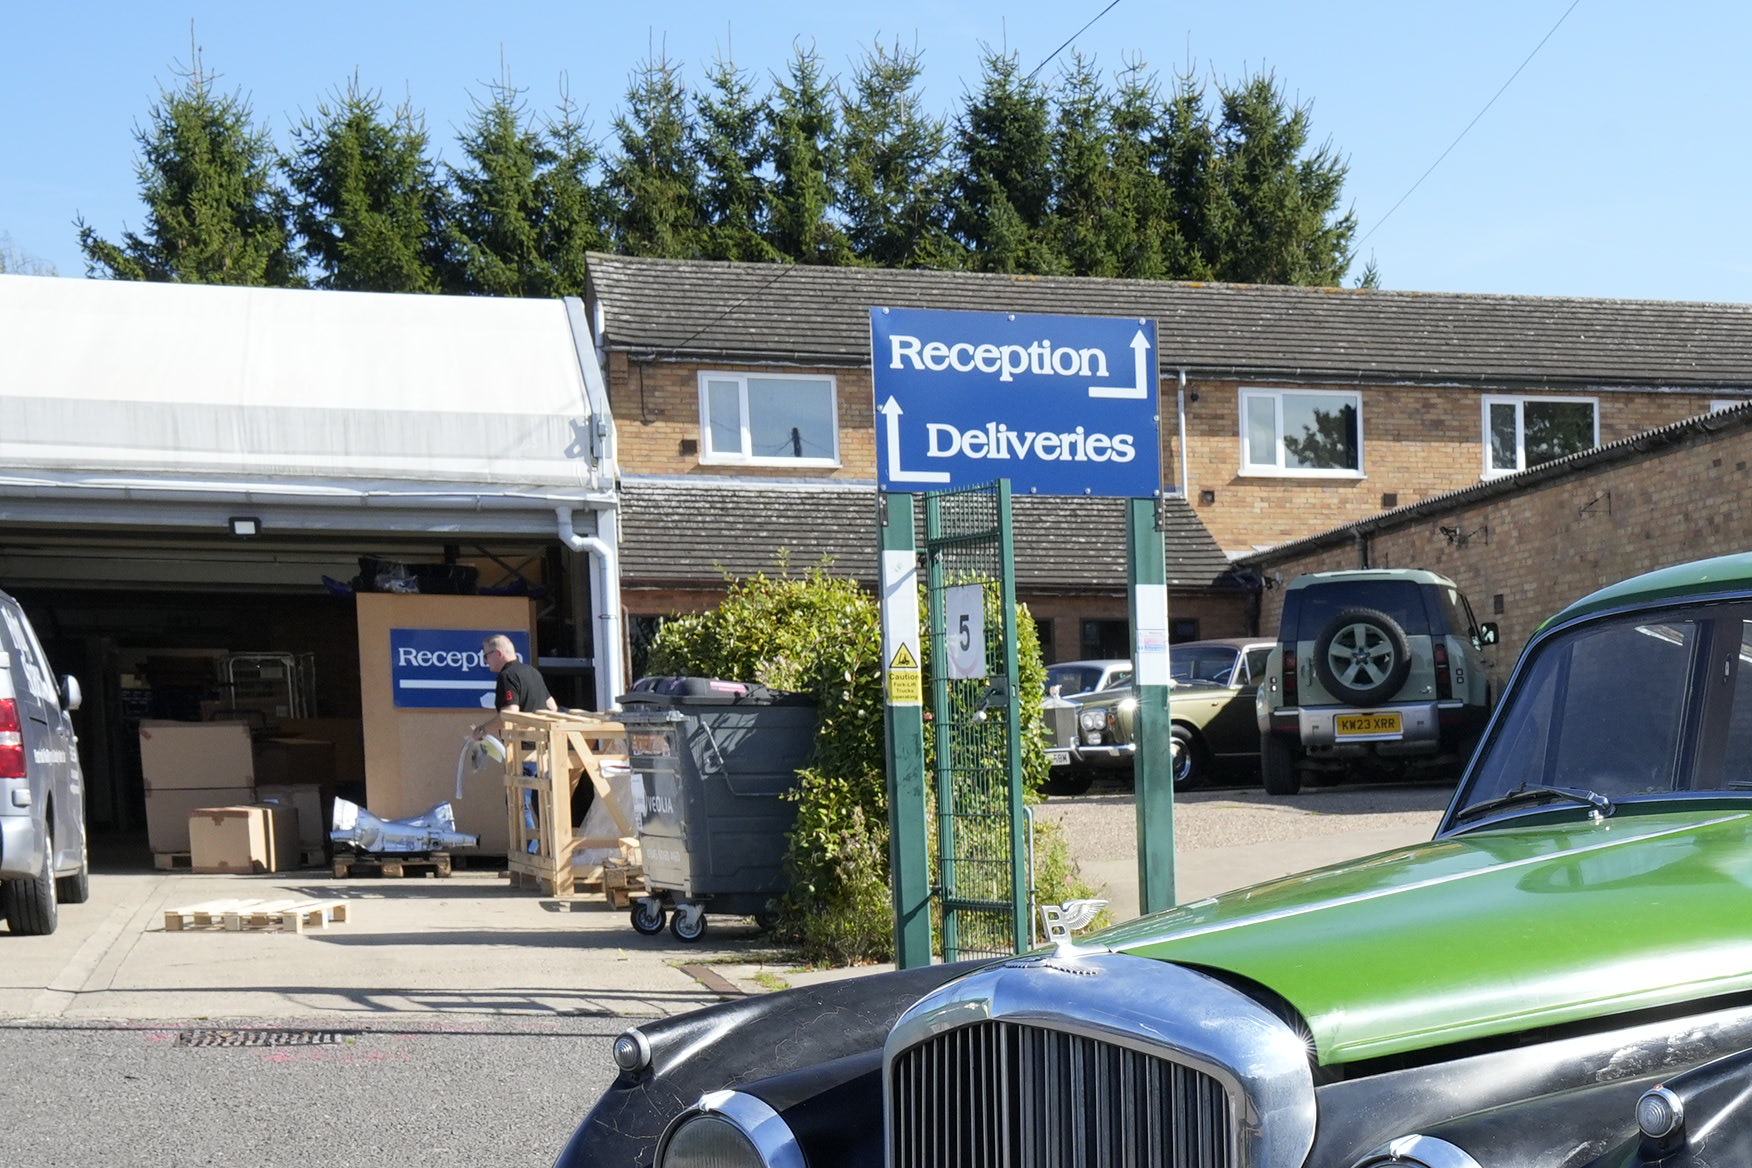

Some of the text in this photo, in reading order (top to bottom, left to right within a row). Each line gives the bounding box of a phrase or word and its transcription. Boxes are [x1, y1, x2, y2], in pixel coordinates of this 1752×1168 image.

[889, 335, 1109, 381] Reception
[926, 421, 1136, 462] Deliveries
[959, 614, 971, 652] 5
[399, 647, 523, 671] Recept
[1342, 718, 1395, 731] KW23 XRR
[648, 795, 674, 814] VEOLIA
